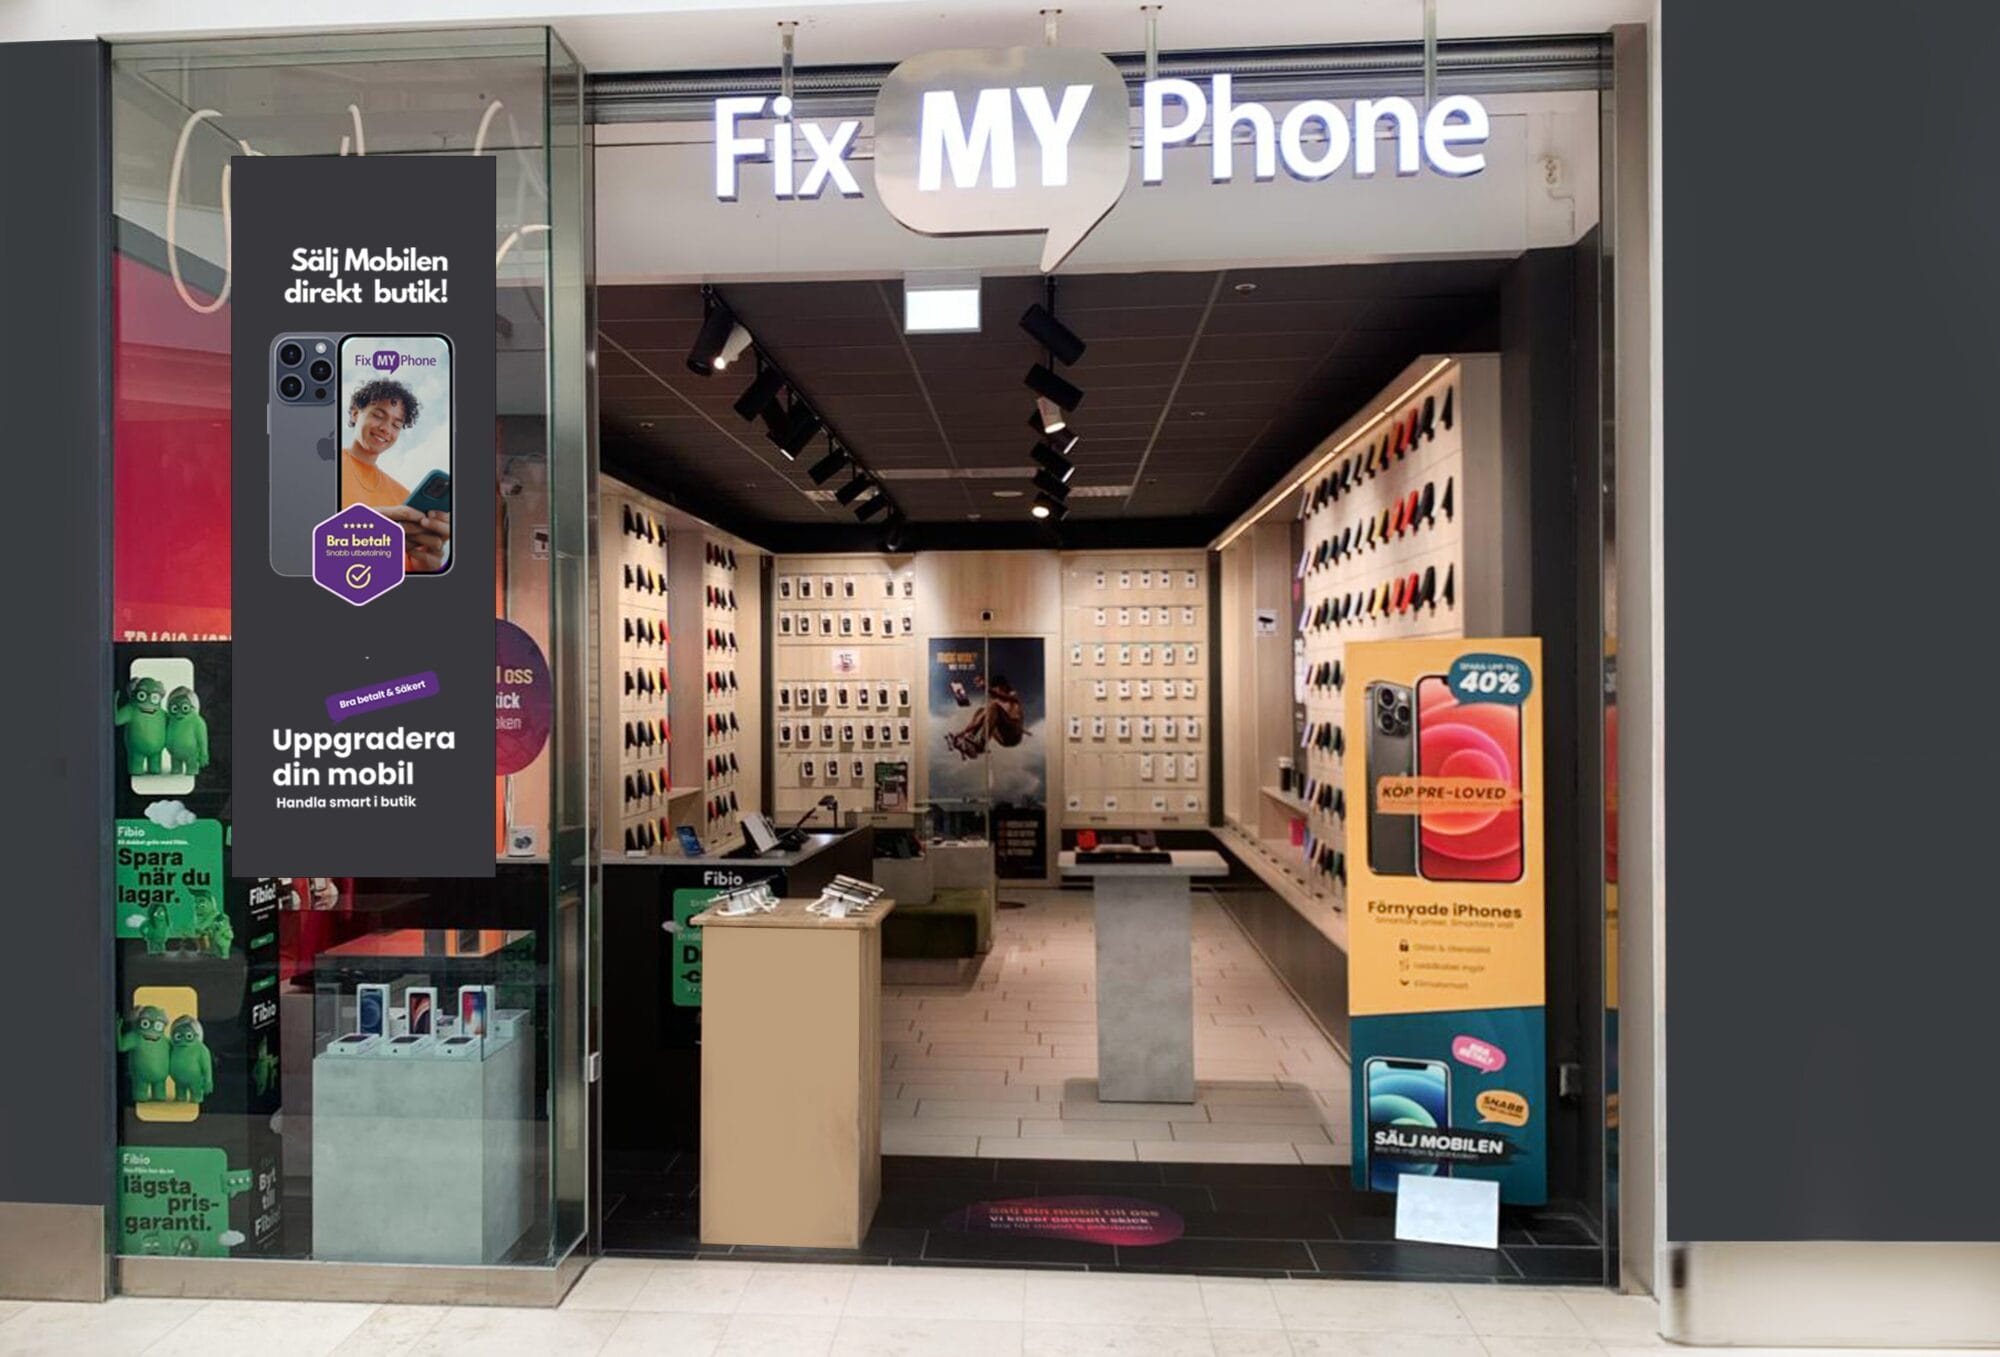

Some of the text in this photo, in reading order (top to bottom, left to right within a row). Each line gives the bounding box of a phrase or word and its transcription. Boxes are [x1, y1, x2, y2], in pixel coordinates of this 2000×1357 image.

[713, 74, 1492, 201] Fix MY Phone
[291, 247, 449, 279] Sälj Mobilen
[284, 279, 449, 304] direkt butik!
[355, 355, 437, 366] Fix MY Phone
[327, 533, 391, 547] Bra betalt
[504, 668, 534, 685] oss
[1459, 671, 1521, 694] 40%
[339, 680, 427, 709] Bra betalt & Säkert
[273, 726, 456, 759] Uppgradera
[273, 760, 414, 786] din mobil
[276, 795, 417, 808] Handla smart i butik
[1382, 782, 1507, 799] KÖP PRE-LOVED
[117, 826, 146, 838] Fibio
[118, 848, 183, 871] Spara
[138, 867, 211, 886] när du
[703, 871, 743, 886] Fibio
[118, 885, 180, 908] lagar.
[1368, 901, 1523, 919] Förnyade iPhones
[1374, 1129, 1418, 1148] SÄLJ
[1420, 1134, 1504, 1155] MOBILEN
[123, 1153, 151, 1166] Fibio
[124, 1174, 192, 1199] lägsta
[168, 1193, 220, 1216] pris-
[125, 1213, 212, 1235] garanti.
